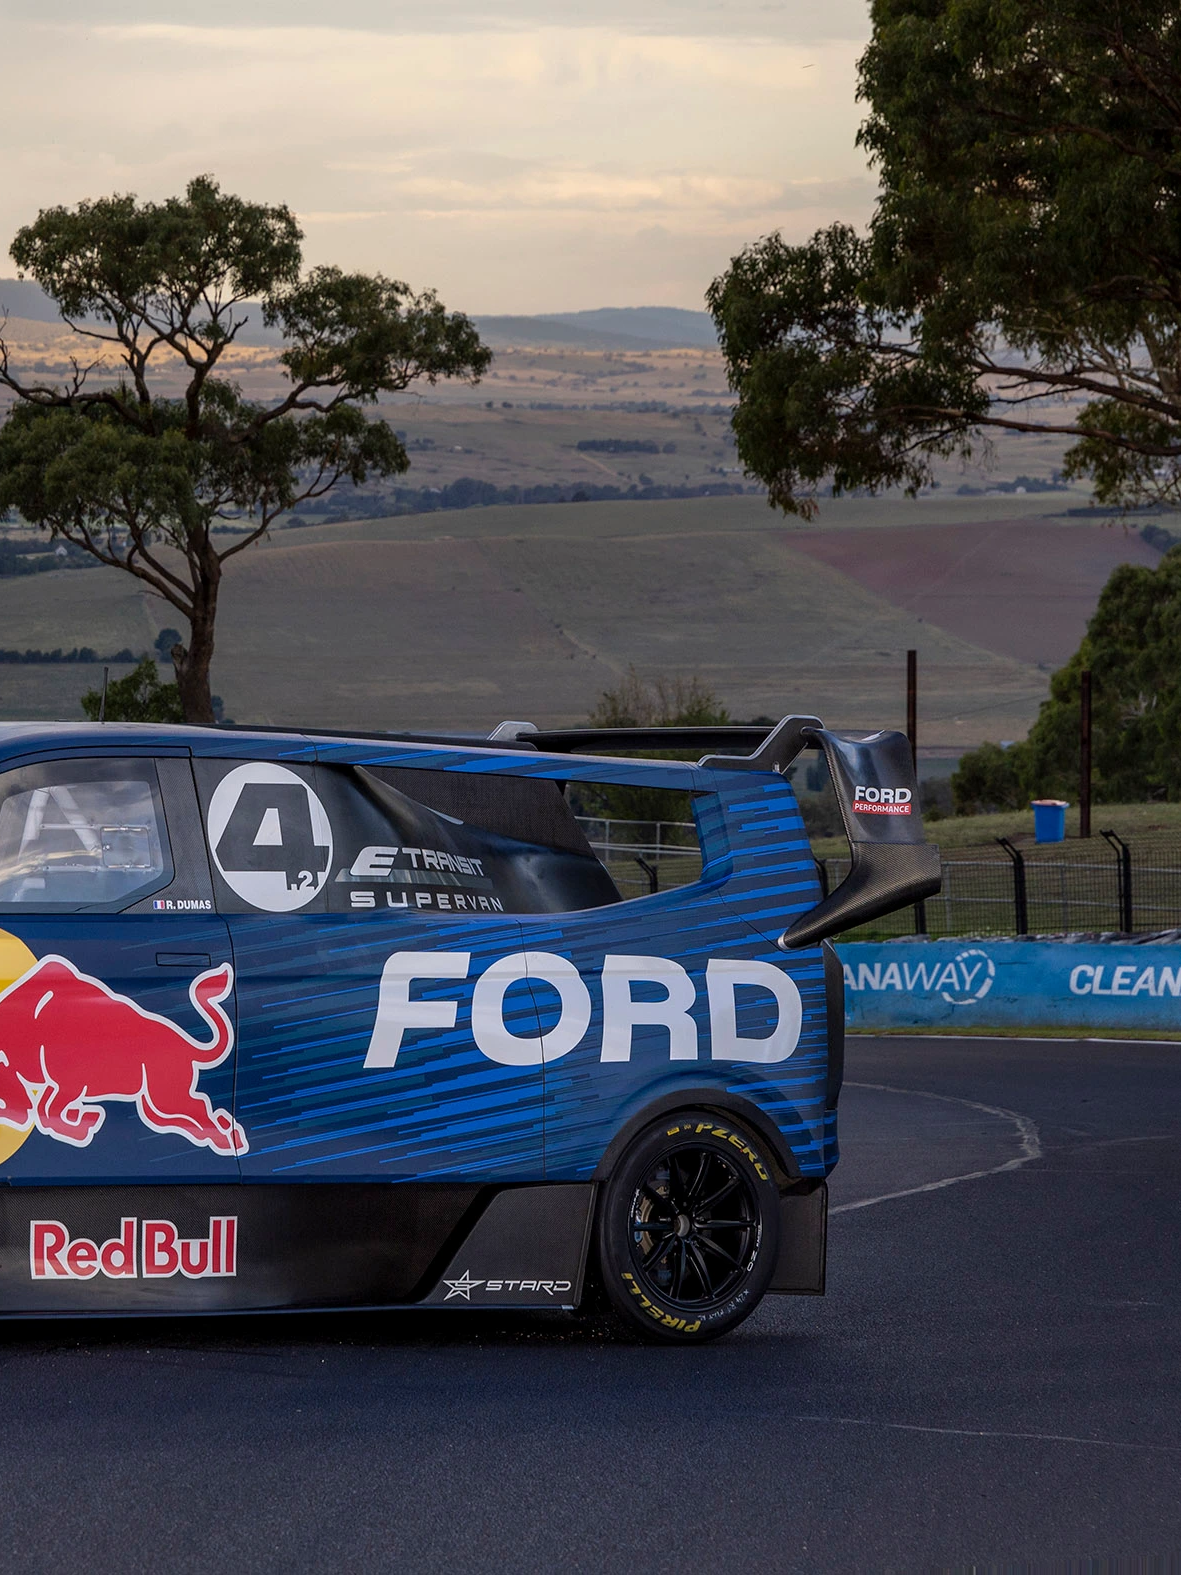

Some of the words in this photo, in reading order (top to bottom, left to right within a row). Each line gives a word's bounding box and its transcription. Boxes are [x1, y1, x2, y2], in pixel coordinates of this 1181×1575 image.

[855, 786, 912, 804] FORD
[854, 803, 910, 813] PERFORMANCE
[401, 847, 483, 876] TRANSIT
[350, 891, 504, 912] SUPERVAN
[363, 952, 802, 1068] FORD
[32, 1218, 136, 1278] Red
[143, 1217, 237, 1277] Bull
[485, 1280, 572, 1296] STARD
[621, 1272, 701, 1332] PIRELLI
